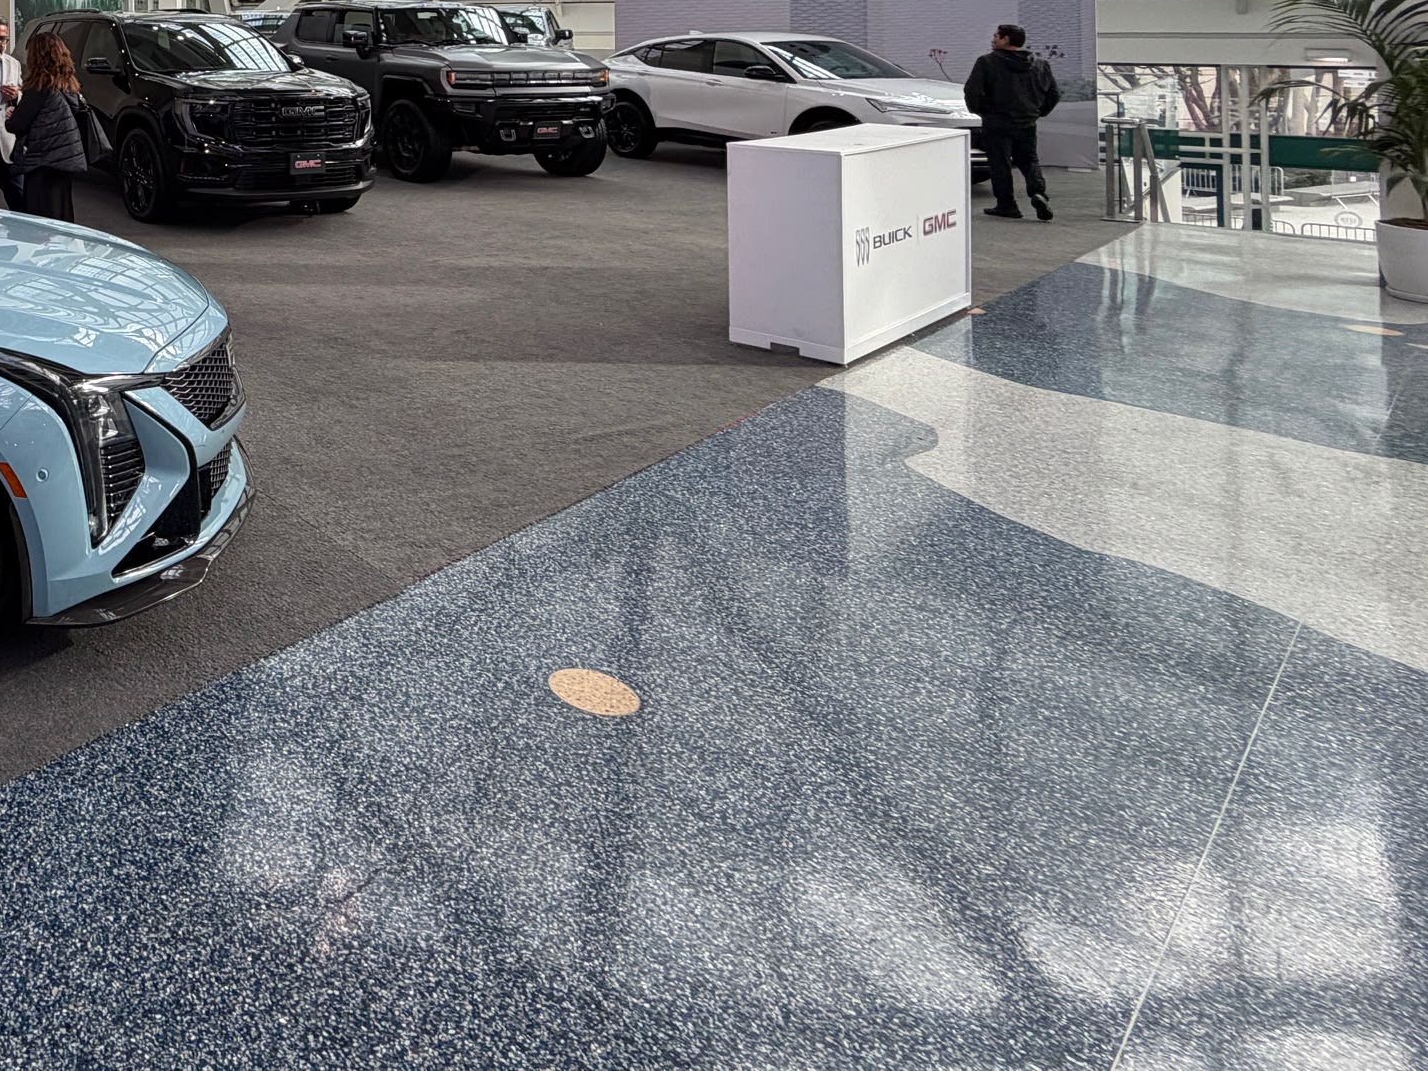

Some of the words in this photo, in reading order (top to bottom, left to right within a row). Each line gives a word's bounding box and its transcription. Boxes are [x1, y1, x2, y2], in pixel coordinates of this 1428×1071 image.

[282, 105, 324, 117] GMC
[295, 159, 321, 169] GMC
[873, 225, 913, 249] BUICK
[923, 209, 957, 236] GMC
